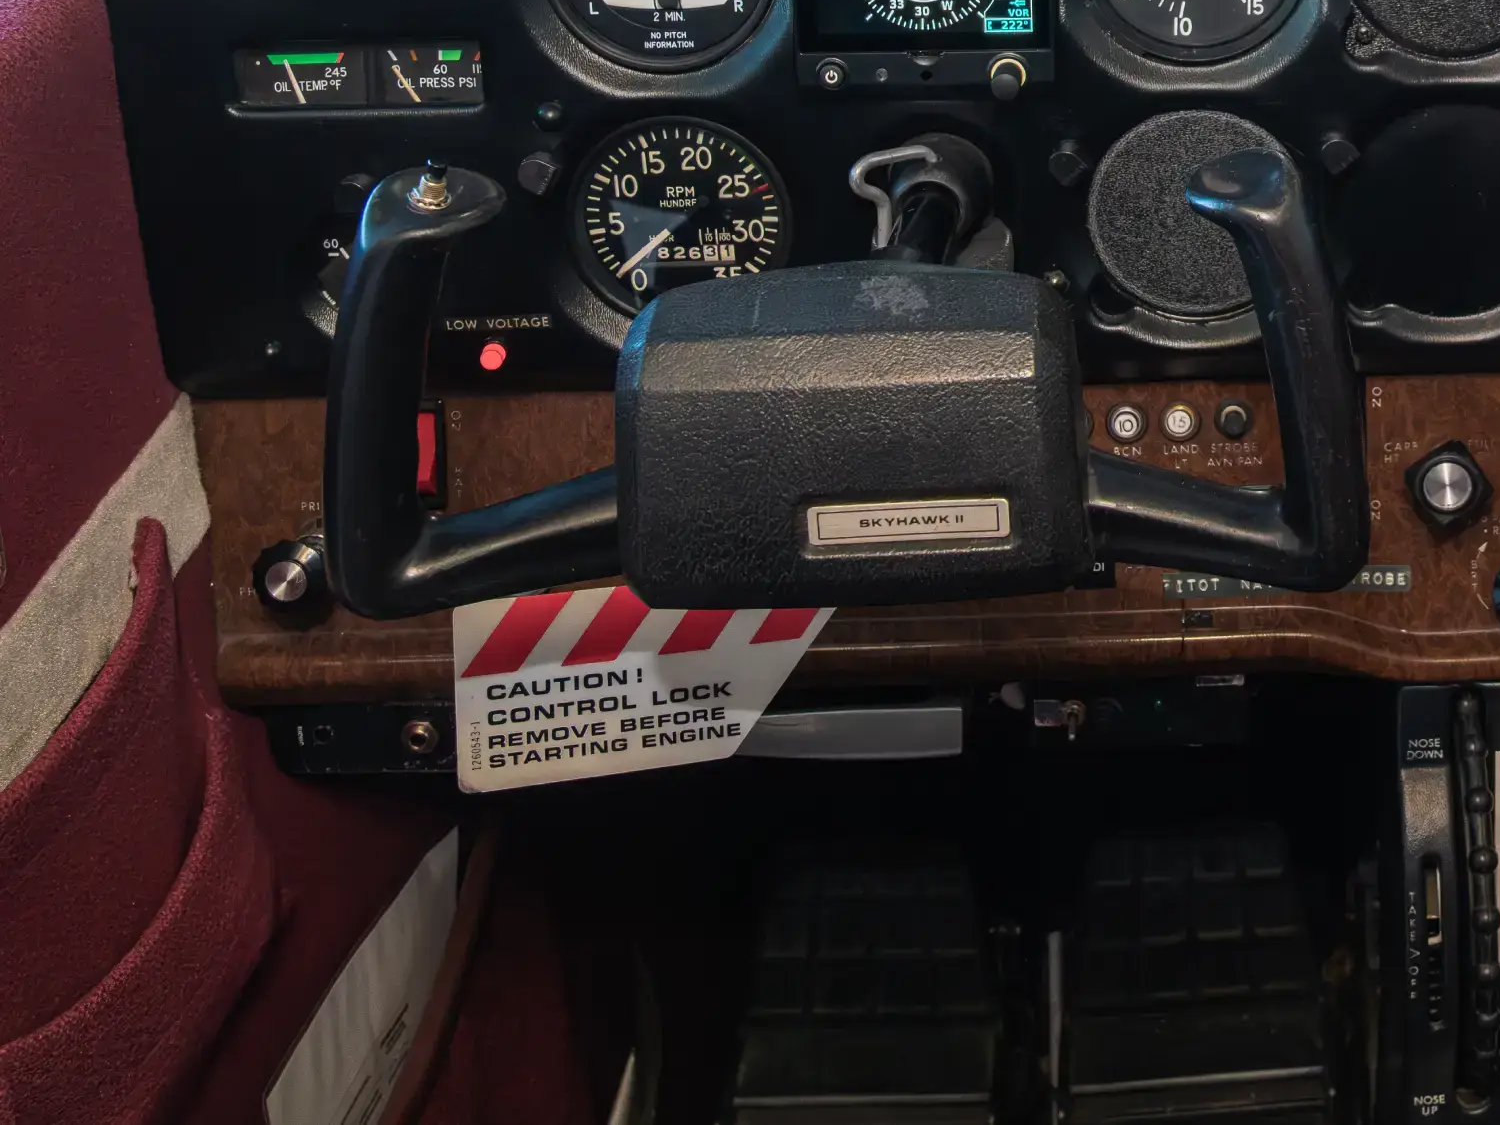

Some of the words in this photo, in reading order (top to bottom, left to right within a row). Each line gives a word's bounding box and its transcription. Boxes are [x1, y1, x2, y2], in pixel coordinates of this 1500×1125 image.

[1008, 9, 1029, 17] VOR
[1001, 21, 1028, 30] 222°
[664, 31, 687, 39] PITCH
[644, 40, 694, 49] INFORMATION
[325, 67, 347, 78] 245
[419, 77, 455, 88] PRESS
[459, 77, 476, 87] PSI
[680, 147, 712, 170] 20
[666, 186, 695, 197] RPM
[447, 320, 477, 330] LOW
[487, 316, 549, 328] VOLTAGE
[859, 515, 950, 528] SKYHAWK
[487, 695, 637, 726] CONTROL
[652, 681, 732, 706] LOCK
[488, 722, 606, 749] REMOVE
[620, 707, 726, 733] BEFORE
[489, 739, 628, 769] STARTING
[642, 723, 742, 749] ENGINE
[1408, 738, 1440, 748] NOSE
[1407, 749, 1444, 760] DOWN
